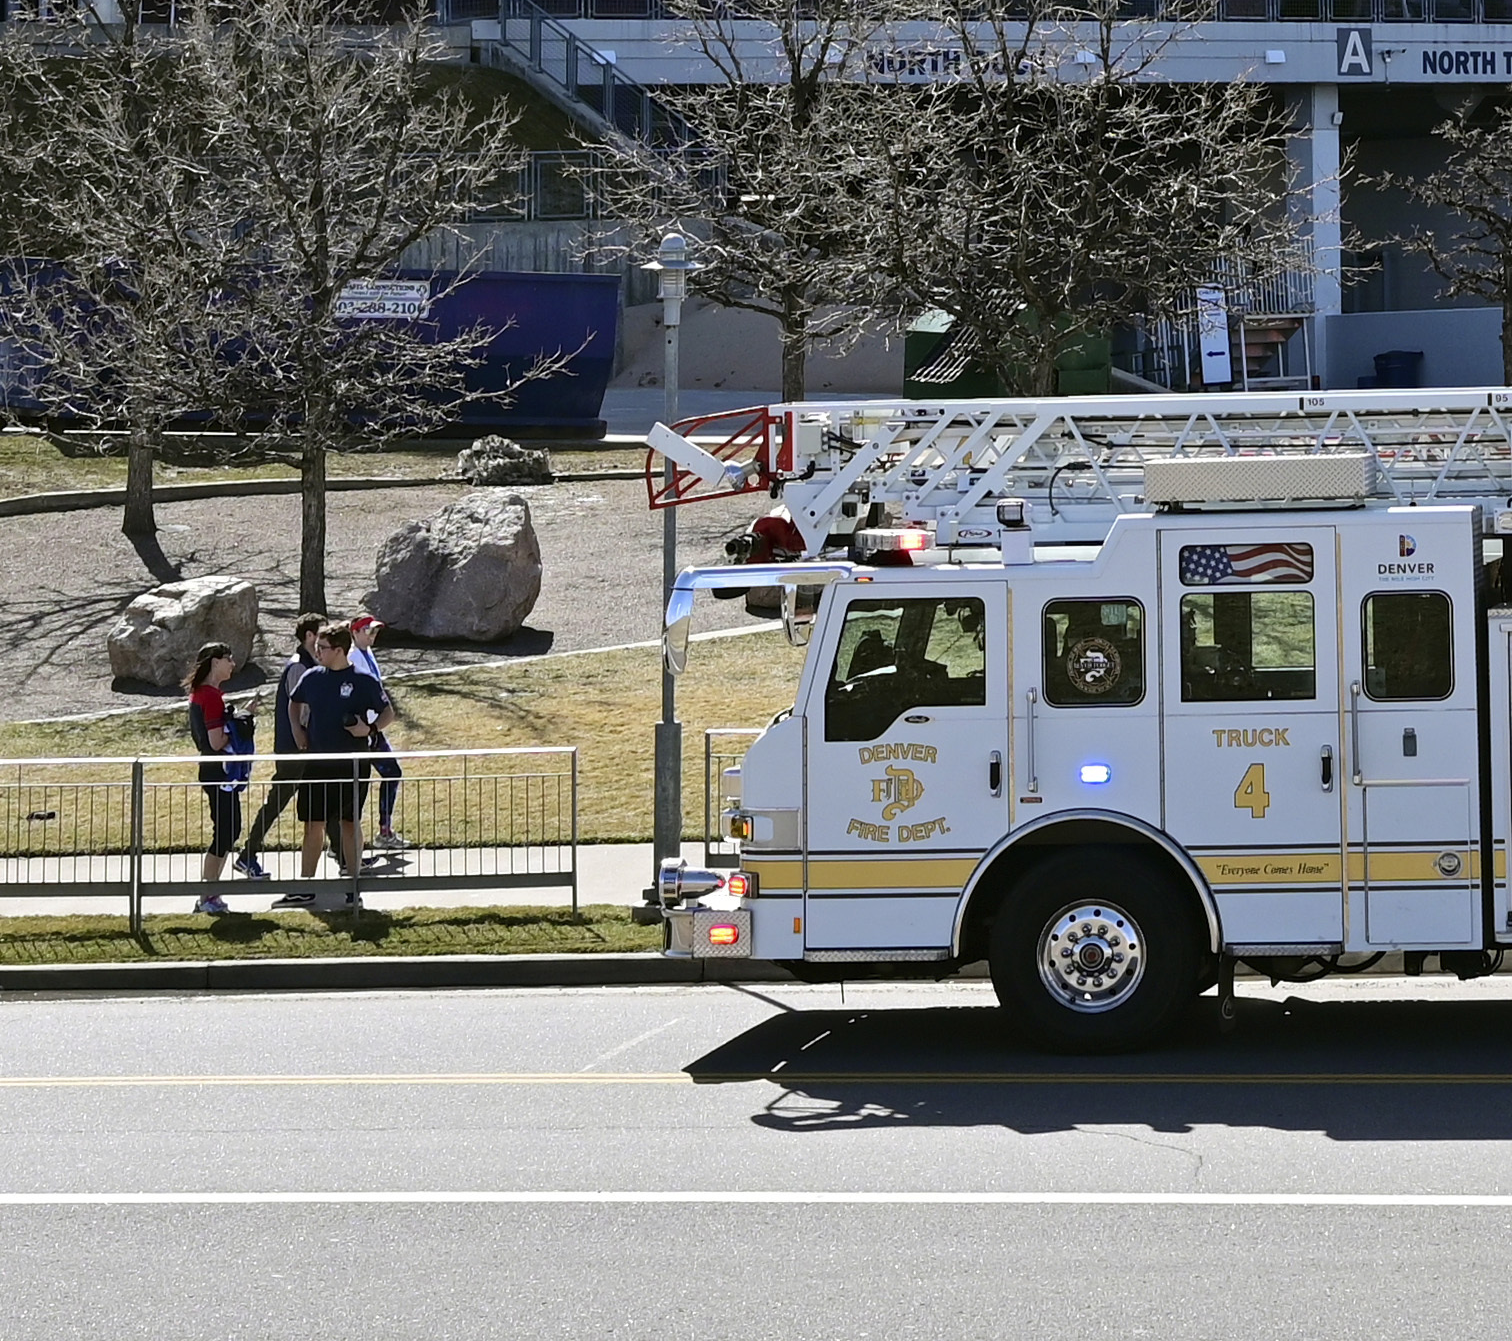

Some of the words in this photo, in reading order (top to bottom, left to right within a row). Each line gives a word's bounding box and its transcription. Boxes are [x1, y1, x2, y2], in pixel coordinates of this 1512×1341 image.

[1340, 31, 1369, 74] A
[1422, 51, 1497, 75] NORTH
[1307, 398, 1325, 407] 105
[1495, 393, 1508, 403] 95
[1378, 563, 1434, 574] DENVER
[1212, 728, 1290, 747] TRUCK
[859, 743, 937, 765] DENVER
[1233, 763, 1270, 819] 4
[846, 818, 890, 842] FIRE
[898, 817, 951, 843] DEPT.
[1263, 863, 1294, 875] Comes
